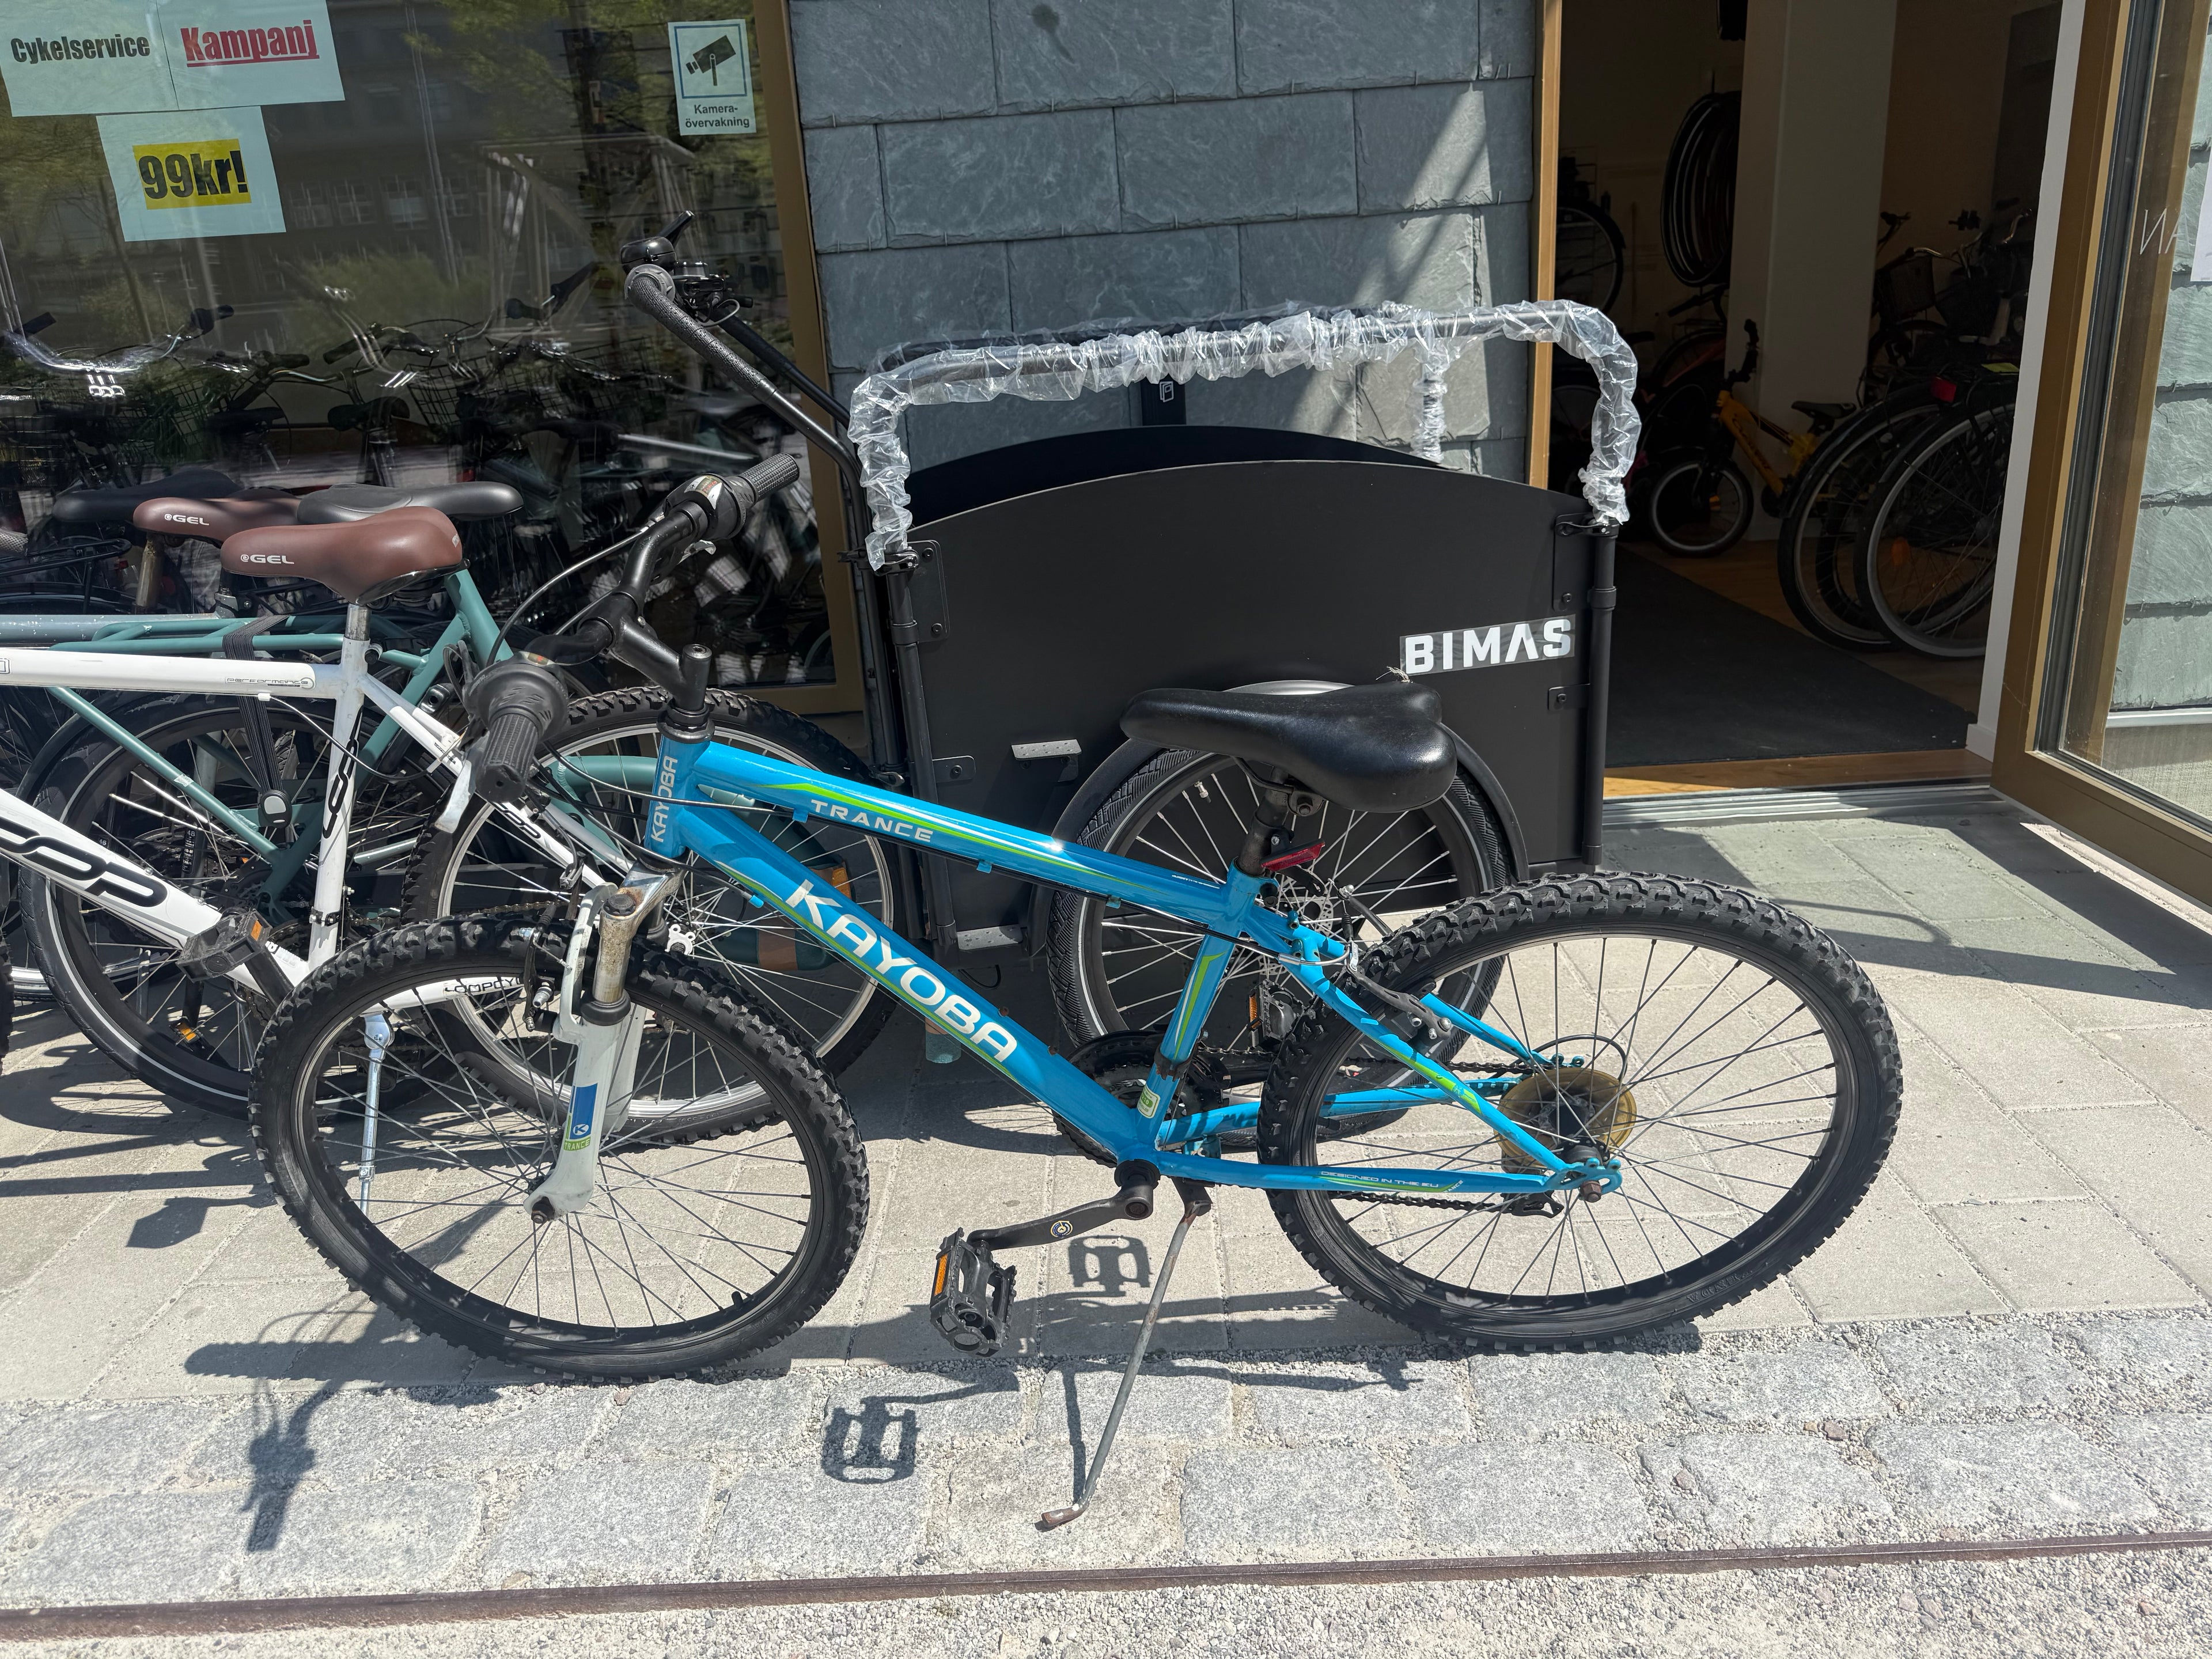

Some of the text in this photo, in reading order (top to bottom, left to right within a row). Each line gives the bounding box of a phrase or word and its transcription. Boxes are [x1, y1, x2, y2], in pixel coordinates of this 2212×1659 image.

[11, 20, 318, 64] Cykelservice Kampanj
[685, 117, 749, 128] övervakning
[694, 104, 738, 114] Kamera-
[138, 150, 249, 199] 99kr!
[650, 755, 678, 843] KAYOBA
[811, 798, 934, 842] TRANCE
[786, 879, 1018, 1063] KAYOBA
[565, 1138, 590, 1150] TRANCE
[1321, 1171, 1379, 1181] DESIGNED
